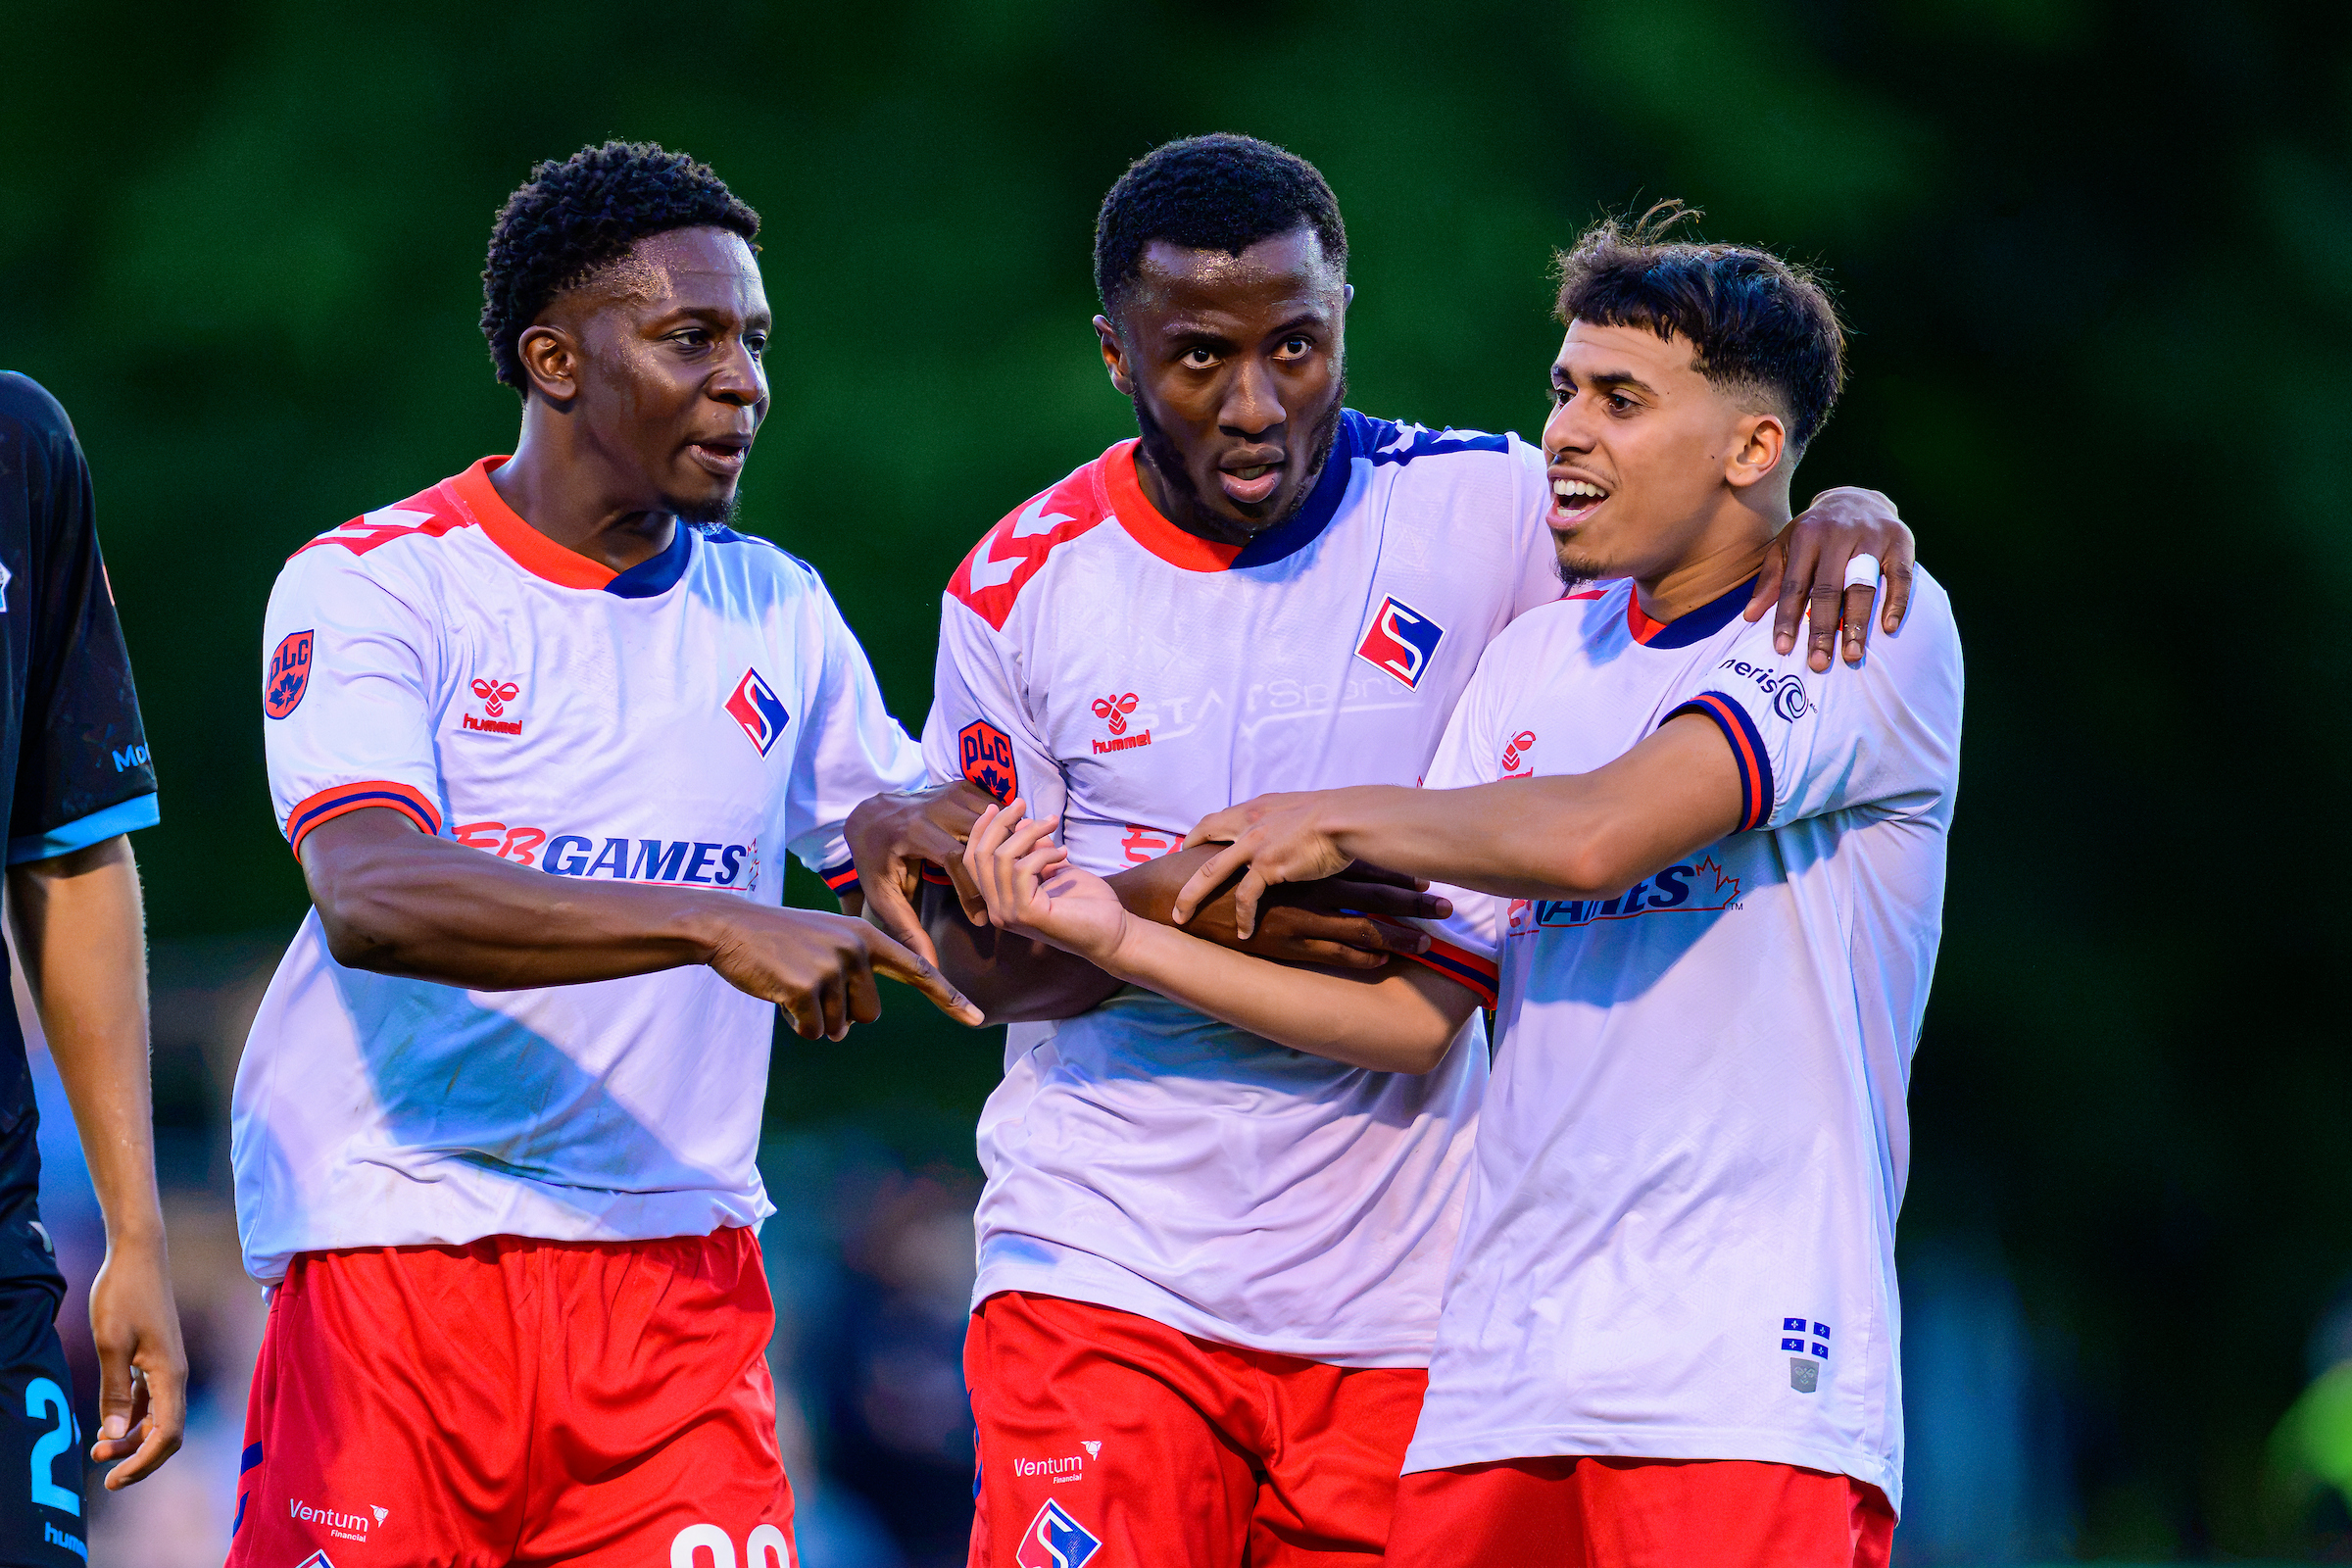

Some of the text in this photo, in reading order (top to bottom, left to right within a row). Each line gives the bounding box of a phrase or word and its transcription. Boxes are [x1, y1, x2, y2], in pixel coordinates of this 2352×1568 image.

[464, 713, 523, 735] hummel
[963, 728, 1010, 771] PLC
[1092, 729, 1152, 755] hummel
[112, 741, 152, 773] Mo
[541, 835, 748, 885] GAMES
[25, 1377, 81, 1517] 2
[1013, 1455, 1083, 1477] Ventum
[1053, 1473, 1083, 1484] Financial
[289, 1497, 369, 1533] Ventum
[330, 1529, 367, 1543] Financial
